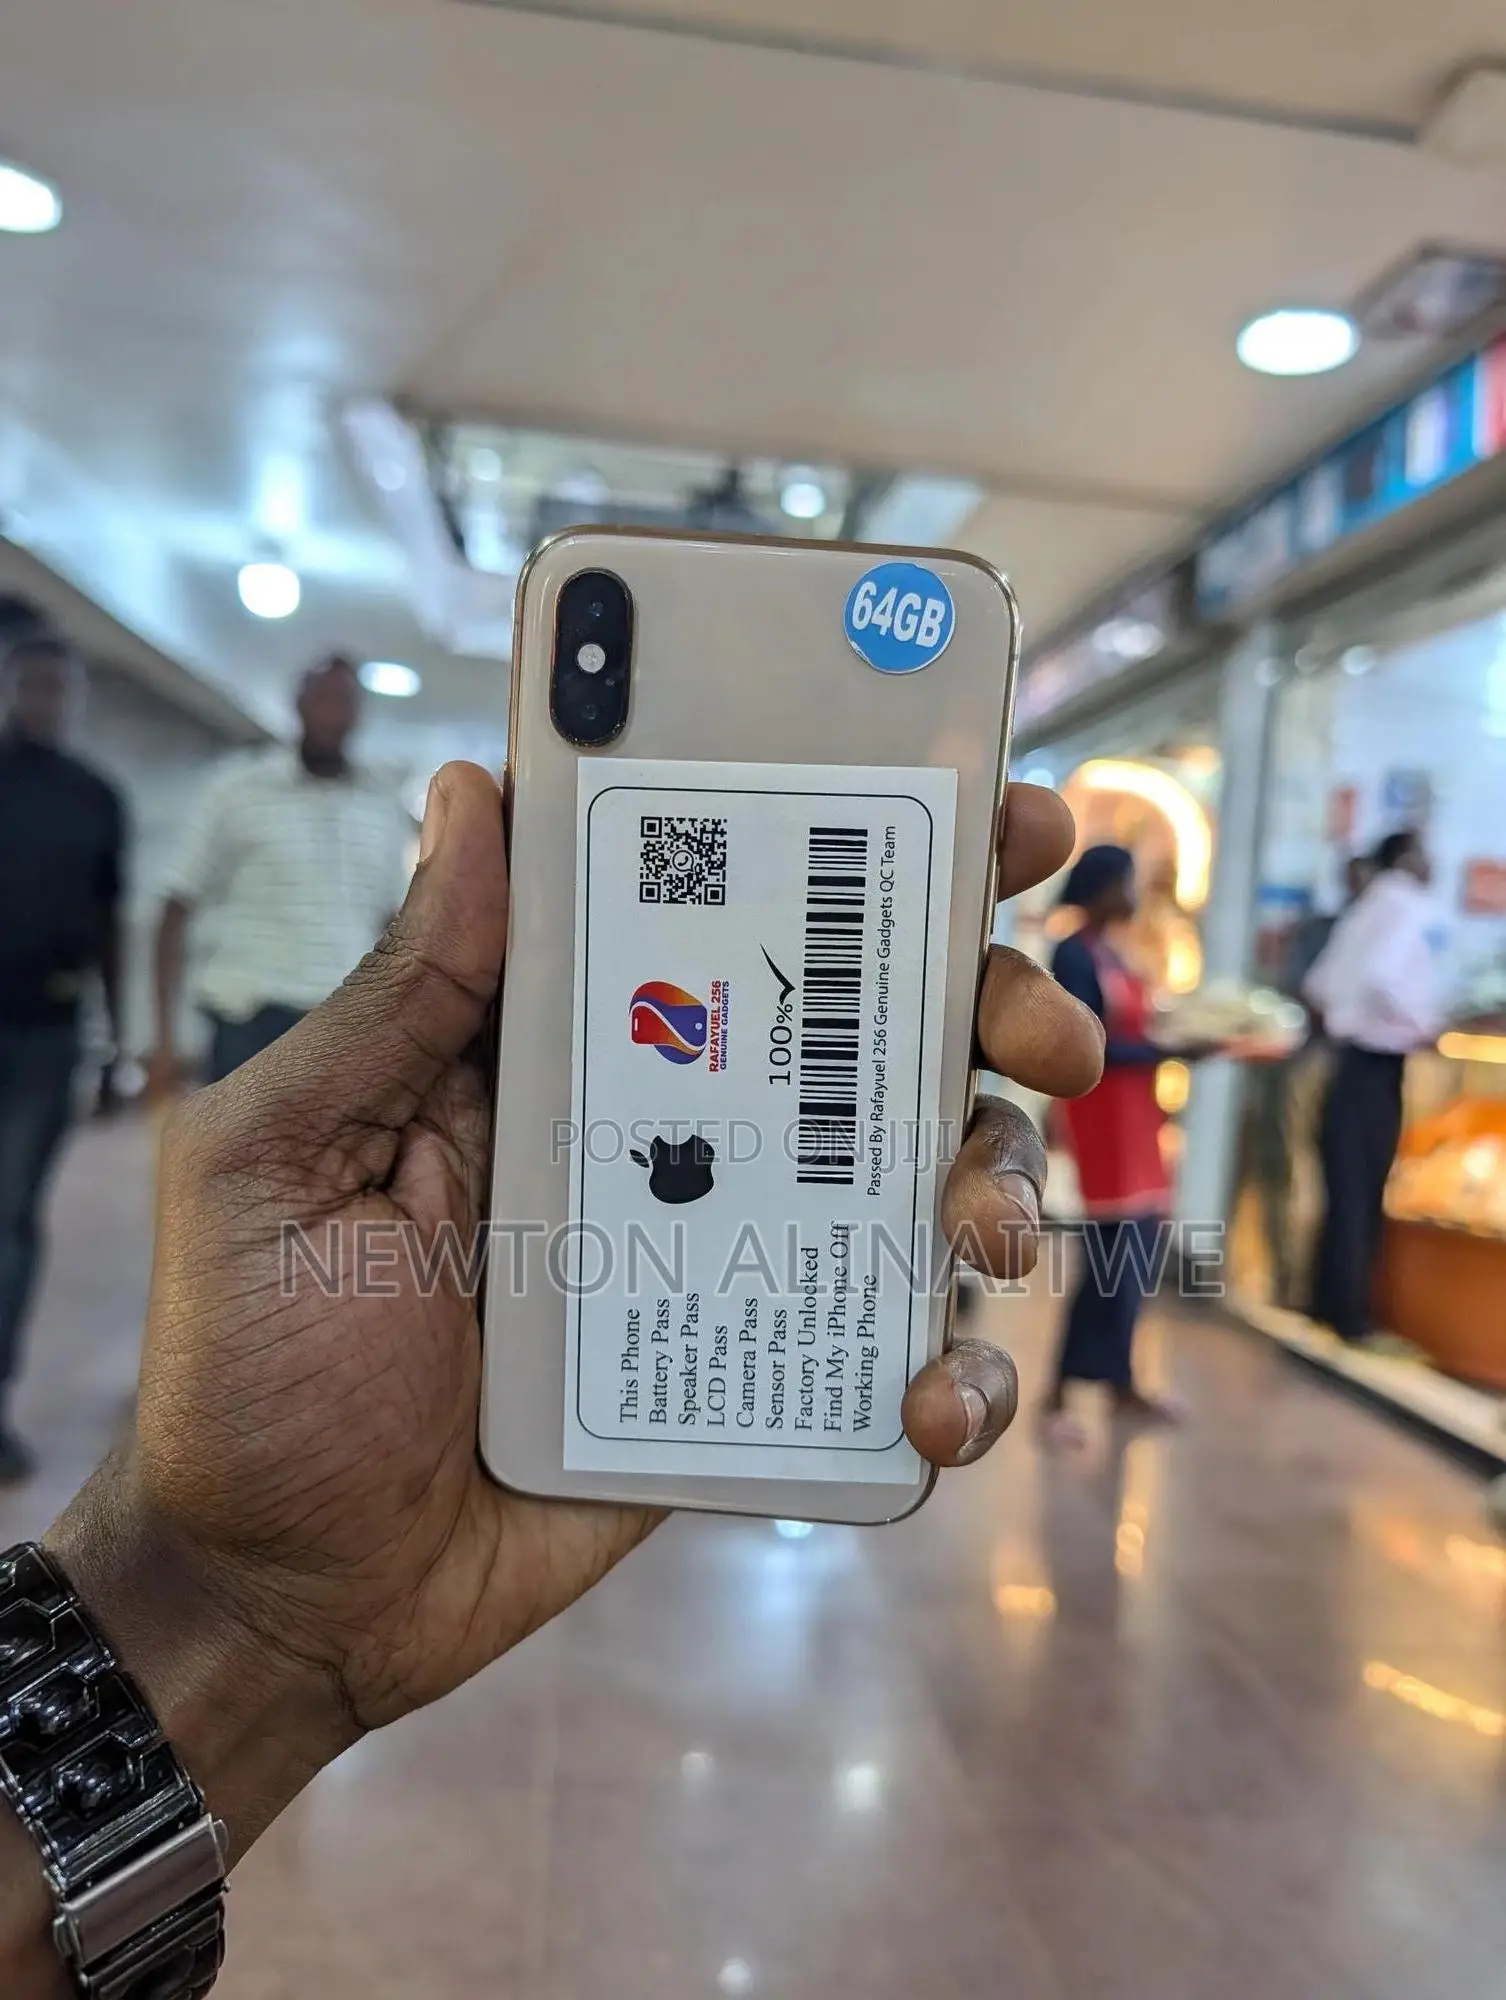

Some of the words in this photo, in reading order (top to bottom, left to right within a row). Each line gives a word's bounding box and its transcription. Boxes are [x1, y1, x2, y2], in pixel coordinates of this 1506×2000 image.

[852, 581, 946, 648] 64GB
[881, 825, 896, 866] Team
[879, 869, 895, 892] QC
[877, 896, 895, 959] Gadgets
[711, 980, 722, 1004] 256
[721, 981, 730, 1025] GADGETS
[874, 962, 889, 1025] Genuine
[709, 1006, 721, 1072] RAFAYUEL
[720, 1029, 728, 1070] GENUINE
[769, 1004, 793, 1085] 100%
[873, 1028, 887, 1056] 256
[870, 1060, 888, 1121] Rafayuel
[869, 1125, 886, 1143] By
[866, 1148, 882, 1196] Passed
[830, 1220, 849, 1259] Off
[651, 1298, 670, 1344] Pass
[680, 1292, 700, 1338] Pass
[739, 1297, 758, 1343] Pass
[798, 1247, 818, 1346] Unlocked
[827, 1266, 847, 1337] iPhone
[857, 1274, 877, 1340] Phone
[621, 1308, 640, 1372] Phone
[709, 1325, 728, 1371] Pass
[768, 1309, 787, 1355] Pass
[678, 1344, 701, 1426] Speaker
[826, 1344, 849, 1380] My
[619, 1379, 639, 1424] This
[649, 1351, 673, 1425] Battery
[707, 1377, 726, 1427] LCD
[736, 1350, 756, 1428] Camera
[766, 1360, 786, 1429] Sensor
[795, 1354, 819, 1431] Factory
[824, 1386, 842, 1432] Find
[853, 1346, 879, 1432] Working
